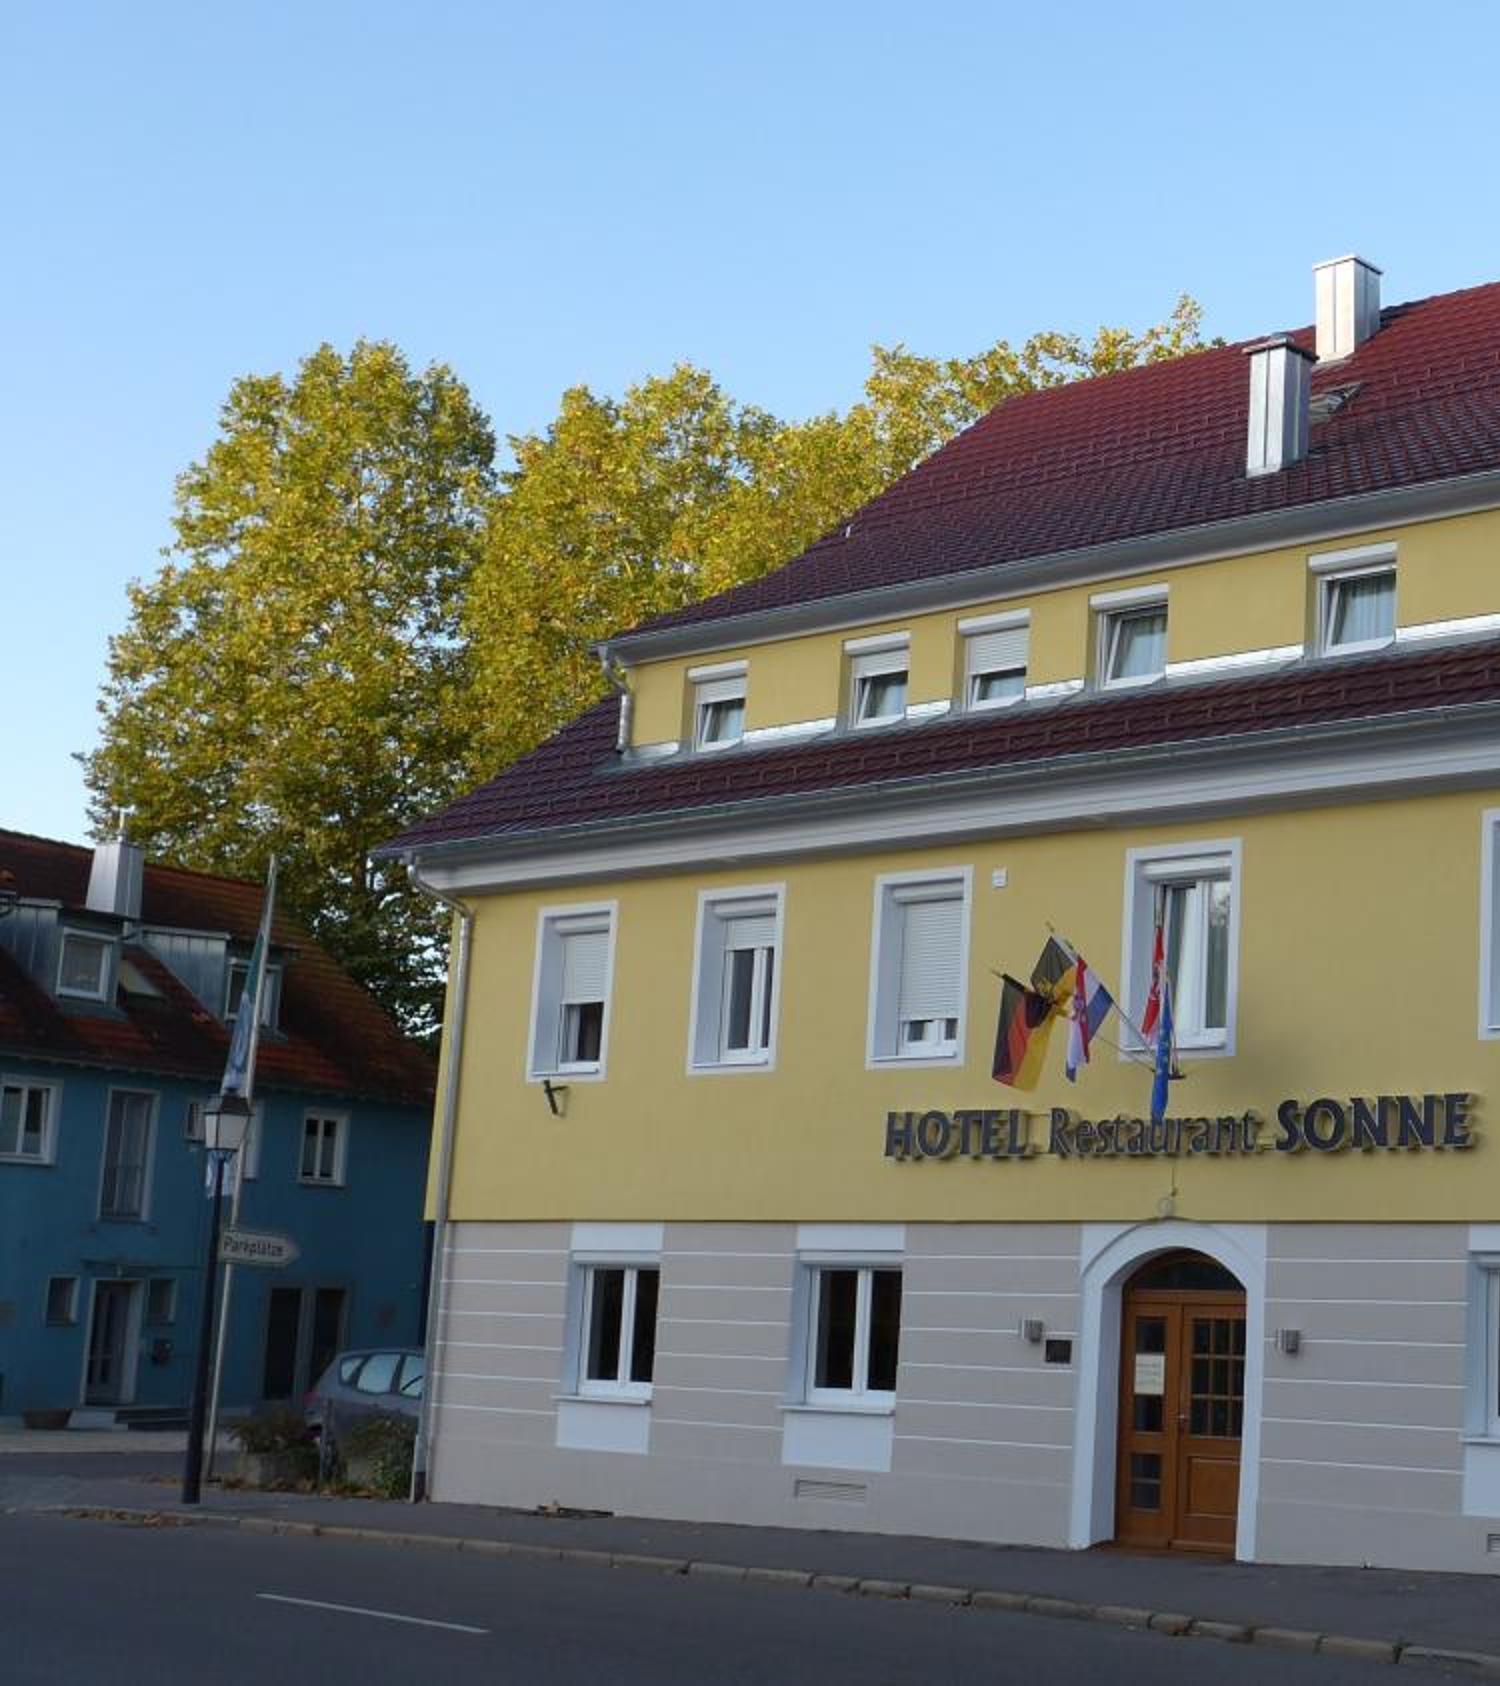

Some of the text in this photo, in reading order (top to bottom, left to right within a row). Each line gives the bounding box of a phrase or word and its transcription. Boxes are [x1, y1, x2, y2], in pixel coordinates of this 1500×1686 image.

[884, 1093, 1472, 1157] HOTEL Restaurant SONNE
